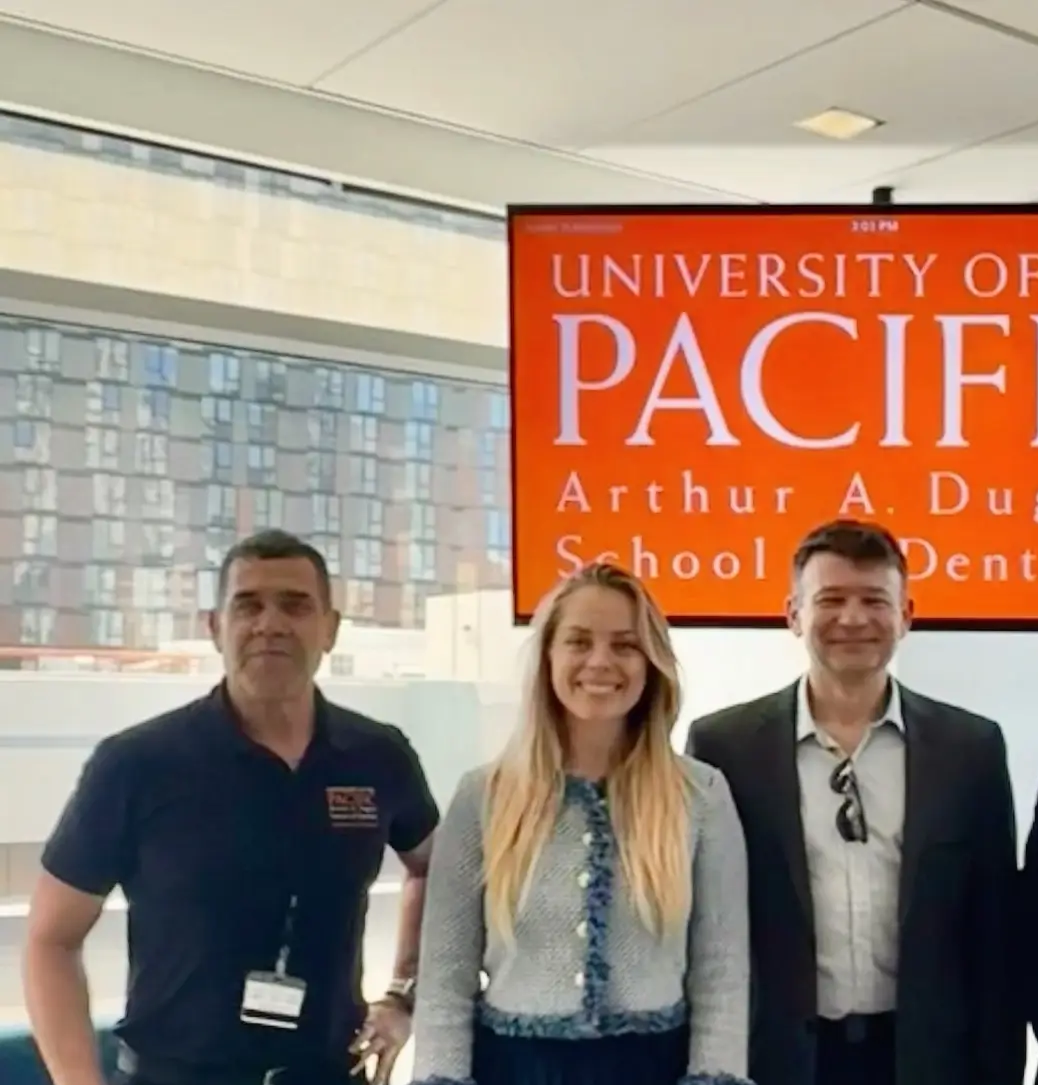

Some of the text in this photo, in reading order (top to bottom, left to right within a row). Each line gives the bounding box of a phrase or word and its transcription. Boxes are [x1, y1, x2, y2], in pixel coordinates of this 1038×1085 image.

[552, 252, 937, 299] UNIVERSITY
[556, 469, 794, 514] Arthur
[838, 471, 895, 516] A.
